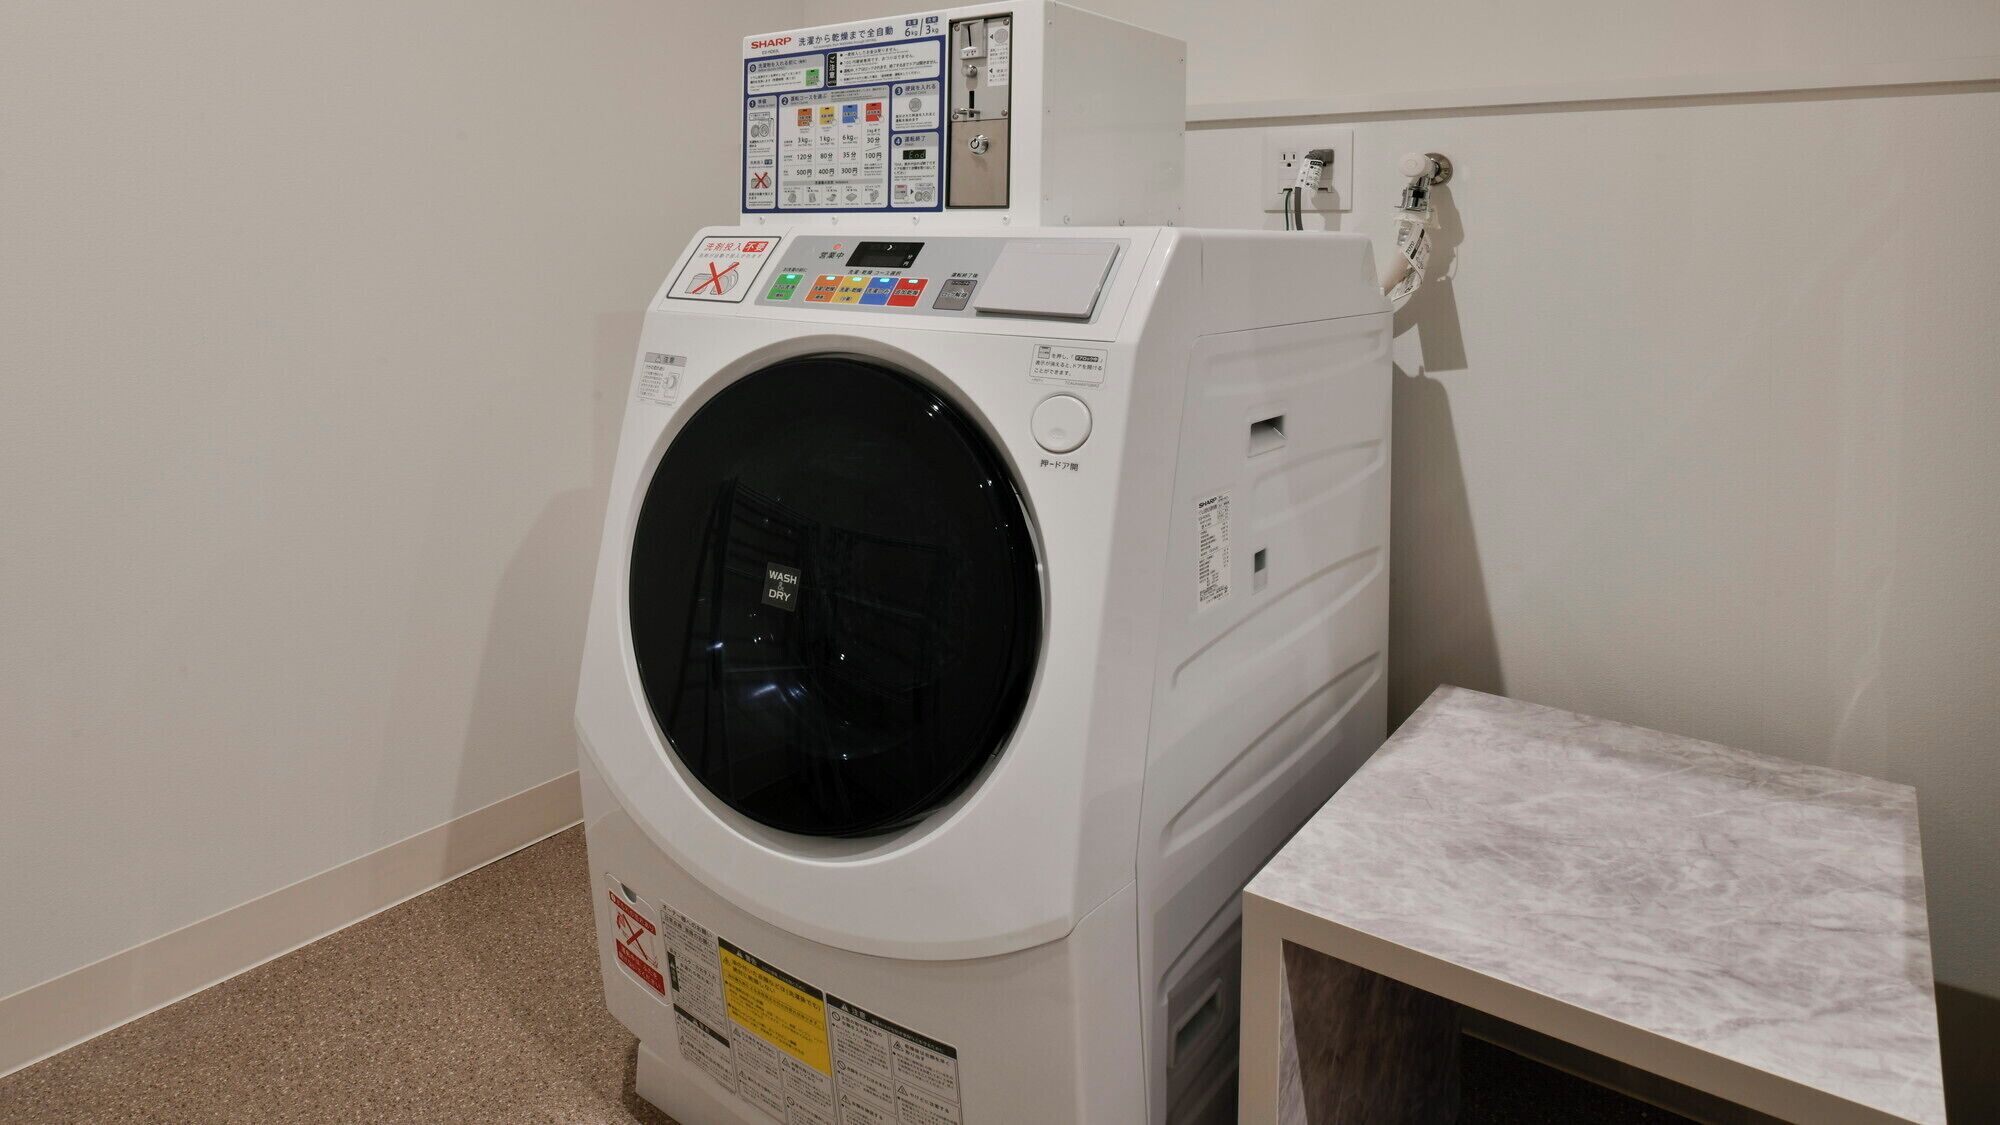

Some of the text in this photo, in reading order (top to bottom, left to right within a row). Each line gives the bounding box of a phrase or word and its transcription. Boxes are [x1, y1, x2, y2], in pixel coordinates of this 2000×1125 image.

[799, 26, 894, 46] 洗濯から乾燥まで全自動
[751, 37, 791, 49] SHARP
[842, 151, 857, 159] 35分
[818, 252, 846, 260] 営業中
[1198, 496, 1218, 509] SHARP
[769, 570, 798, 585] WASH
[777, 582, 785, 592] &
[768, 588, 791, 602] DRY
